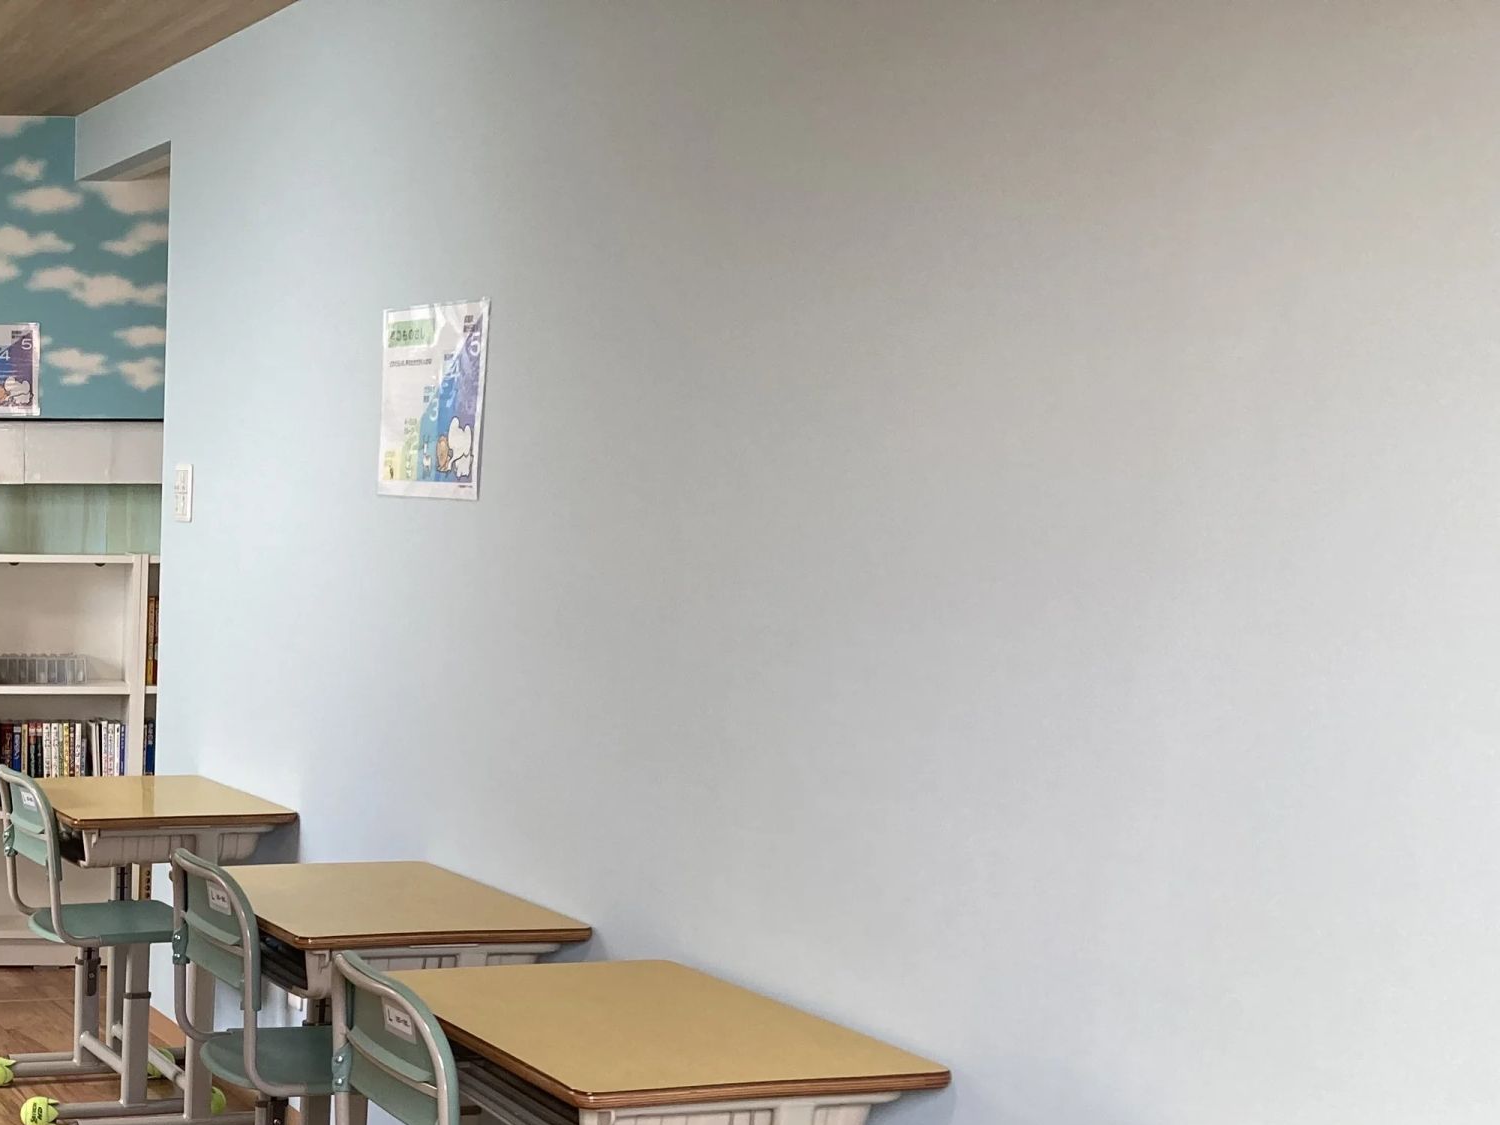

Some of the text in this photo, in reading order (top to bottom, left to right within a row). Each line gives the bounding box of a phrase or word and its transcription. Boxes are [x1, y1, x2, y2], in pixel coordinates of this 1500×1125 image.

[21, 339, 32, 350] 5
[469, 333, 481, 357] 5
[0, 350, 11, 360] 4
[430, 399, 439, 421] 3
